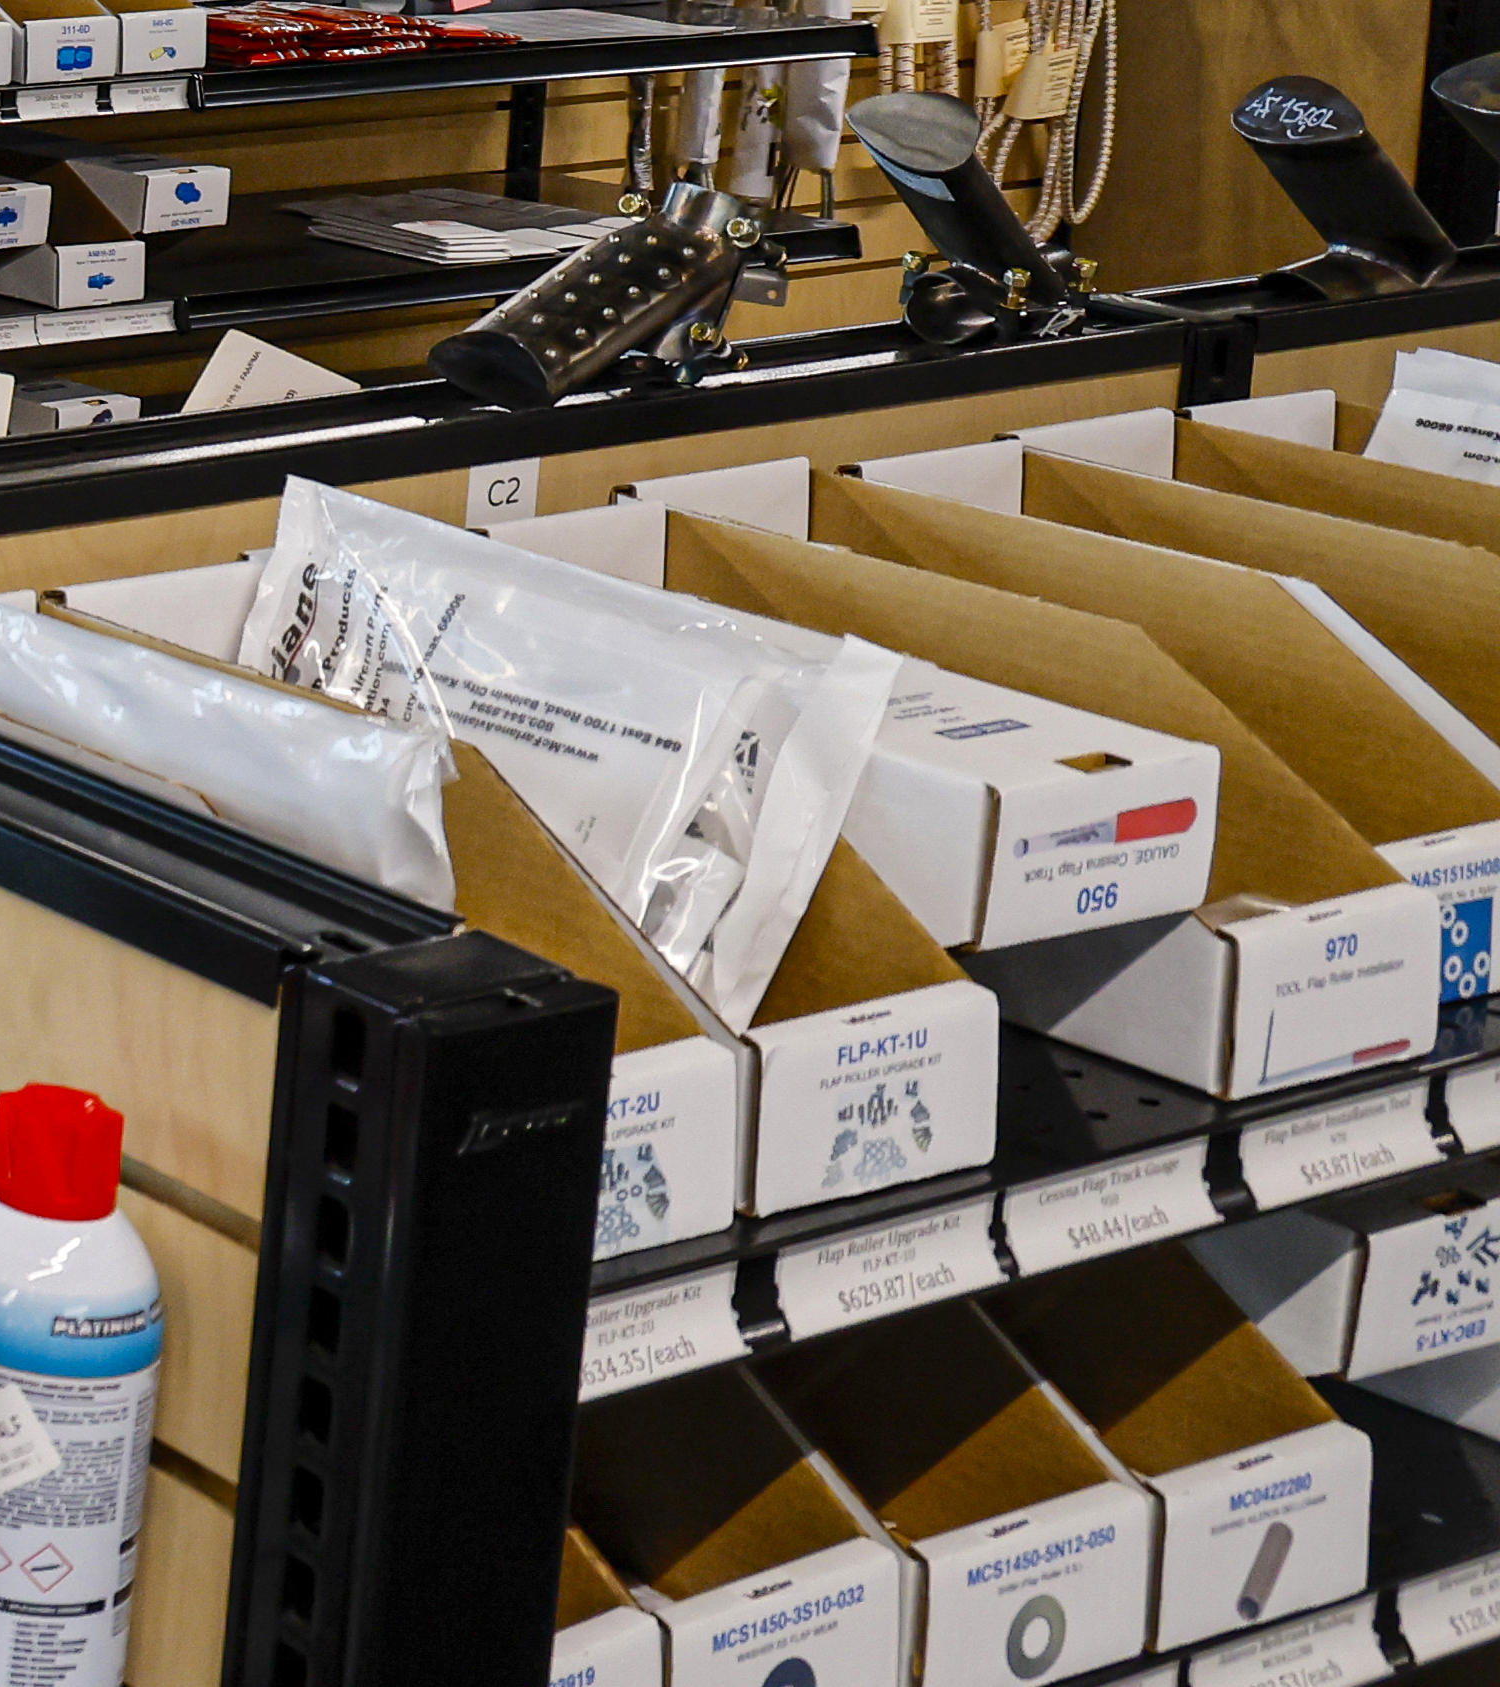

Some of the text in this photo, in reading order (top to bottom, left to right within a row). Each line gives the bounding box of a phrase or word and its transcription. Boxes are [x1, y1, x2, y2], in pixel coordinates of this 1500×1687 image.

[1415, 418, 1454, 432] 66006
[487, 477, 520, 508] C2
[322, 568, 357, 672] Products
[488, 686, 542, 711] Baldwin
[543, 700, 580, 727] Road,
[582, 716, 616, 735] 1700
[620, 727, 650, 745] East
[1024, 842, 1180, 883] GAUGE, Cessna Flap Track
[1076, 881, 1118, 915] 950
[1325, 933, 1359, 961] 970
[1306, 974, 1327, 992] Flap
[1328, 968, 1354, 985] Roller
[1355, 959, 1405, 981] Installation
[838, 1028, 929, 1066] FLP-KT-1U
[819, 1052, 942, 1091] FLAP ROLLER UPGRADE KIT
[607, 1092, 661, 1121] KT-2U
[611, 1116, 676, 1142] UPGRADE KIT
[1264, 1126, 1289, 1147] Flap
[1301, 1142, 1397, 1187] $43.87/each
[1038, 1158, 1181, 1206] Cessna Flap Track Gauge
[817, 1215, 961, 1265] Flap Roller Upgrade Kit
[1067, 1205, 1169, 1249] $48.44/each
[587, 1285, 702, 1327] oller Upgrade Kit
[838, 1264, 956, 1314] $629.87/each
[51, 1310, 147, 1338] PLATINUM
[583, 1334, 697, 1386] 634.35/each
[967, 1524, 1116, 1588] MCS1450-5N12-050
[712, 1583, 866, 1655] MCS1450-3S10-032
[814, 1620, 839, 1639] WEAR
